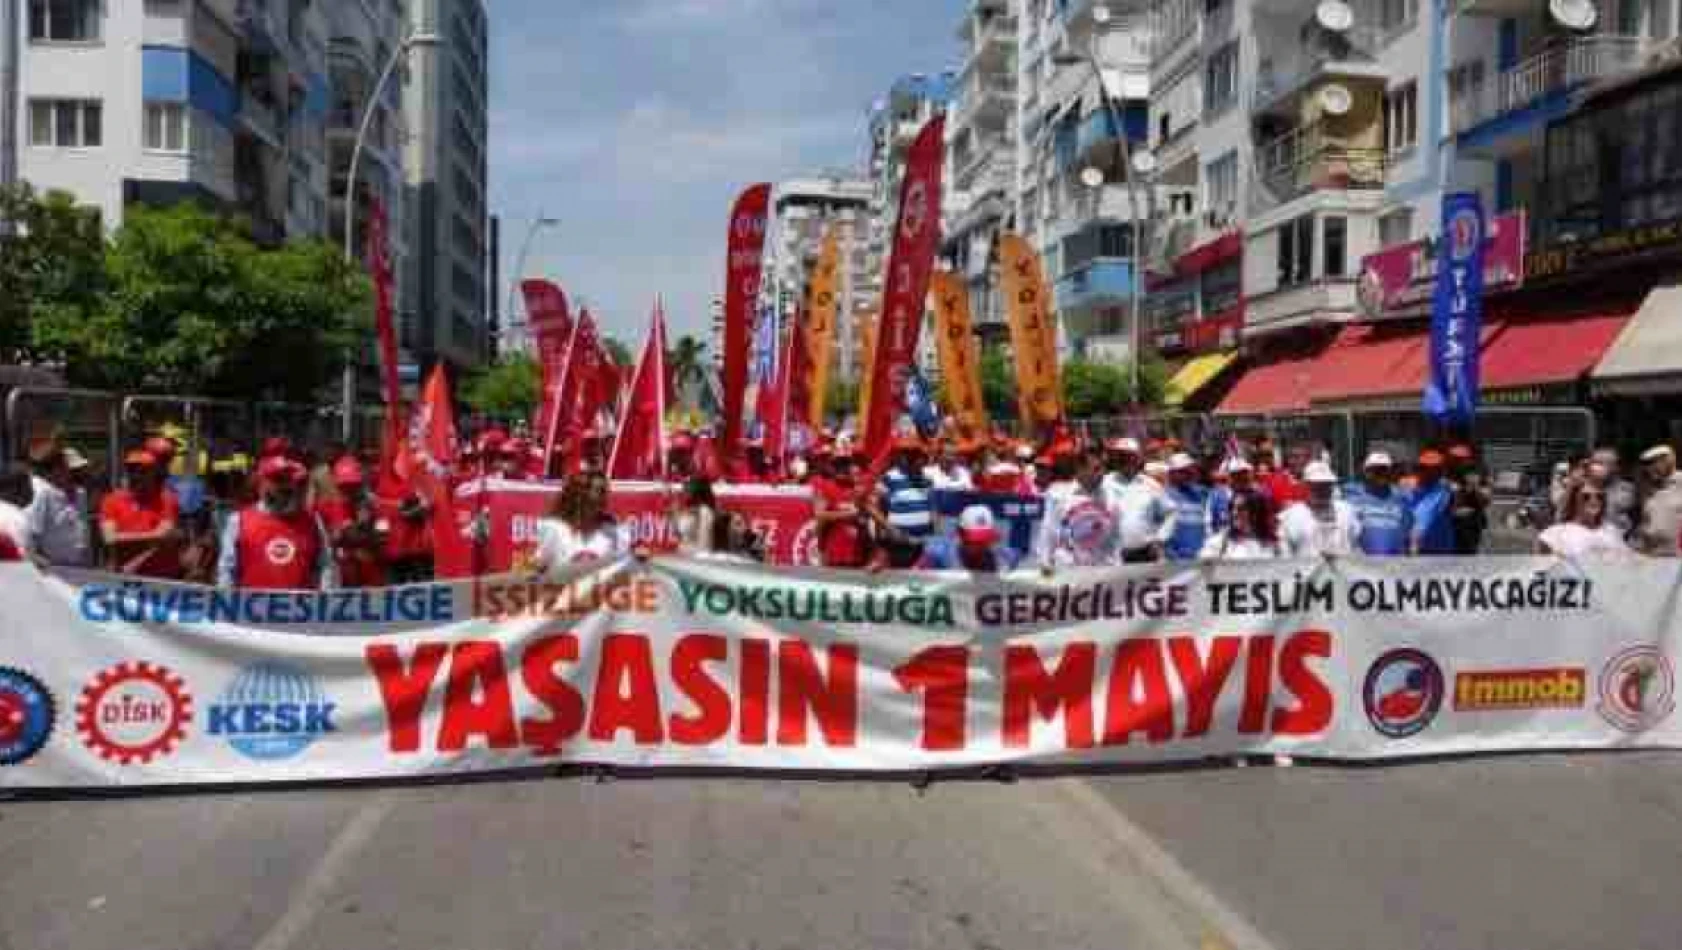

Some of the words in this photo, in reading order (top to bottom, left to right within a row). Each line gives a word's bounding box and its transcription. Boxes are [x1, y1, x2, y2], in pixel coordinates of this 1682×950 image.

[677, 577, 956, 626] YOKSULLUĞA
[1206, 571, 1333, 614] TESLİM
[1348, 570, 1594, 612] OLMAYACAĞIZ!
[364, 633, 860, 755] YAŞASIN
[891, 643, 969, 750] 1
[1002, 630, 1333, 750] MAYIS
[1456, 672, 1581, 707] tmmob
[206, 702, 337, 734] KESK
